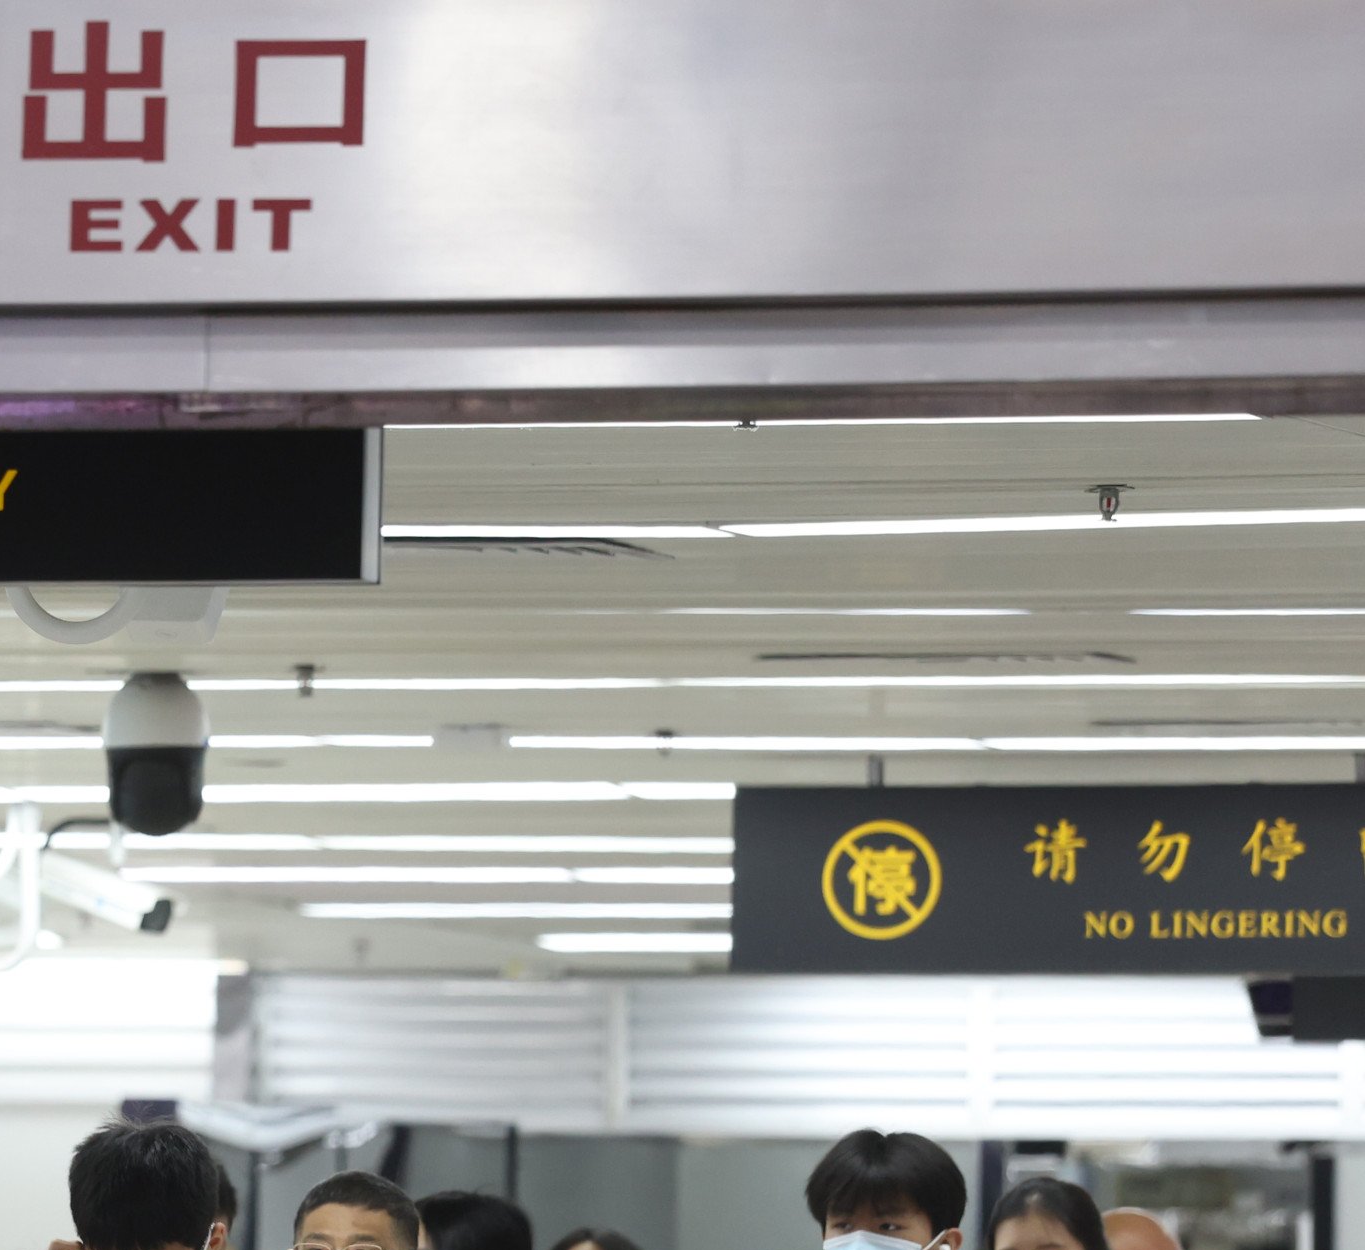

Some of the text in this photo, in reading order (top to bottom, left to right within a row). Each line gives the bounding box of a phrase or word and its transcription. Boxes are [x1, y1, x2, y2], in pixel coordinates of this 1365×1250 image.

[21, 21, 366, 163] 出口
[70, 199, 311, 252] EXIT
[1024, 817, 1365, 884] 请勿停
[1084, 909, 1348, 940] NO LINGERING
